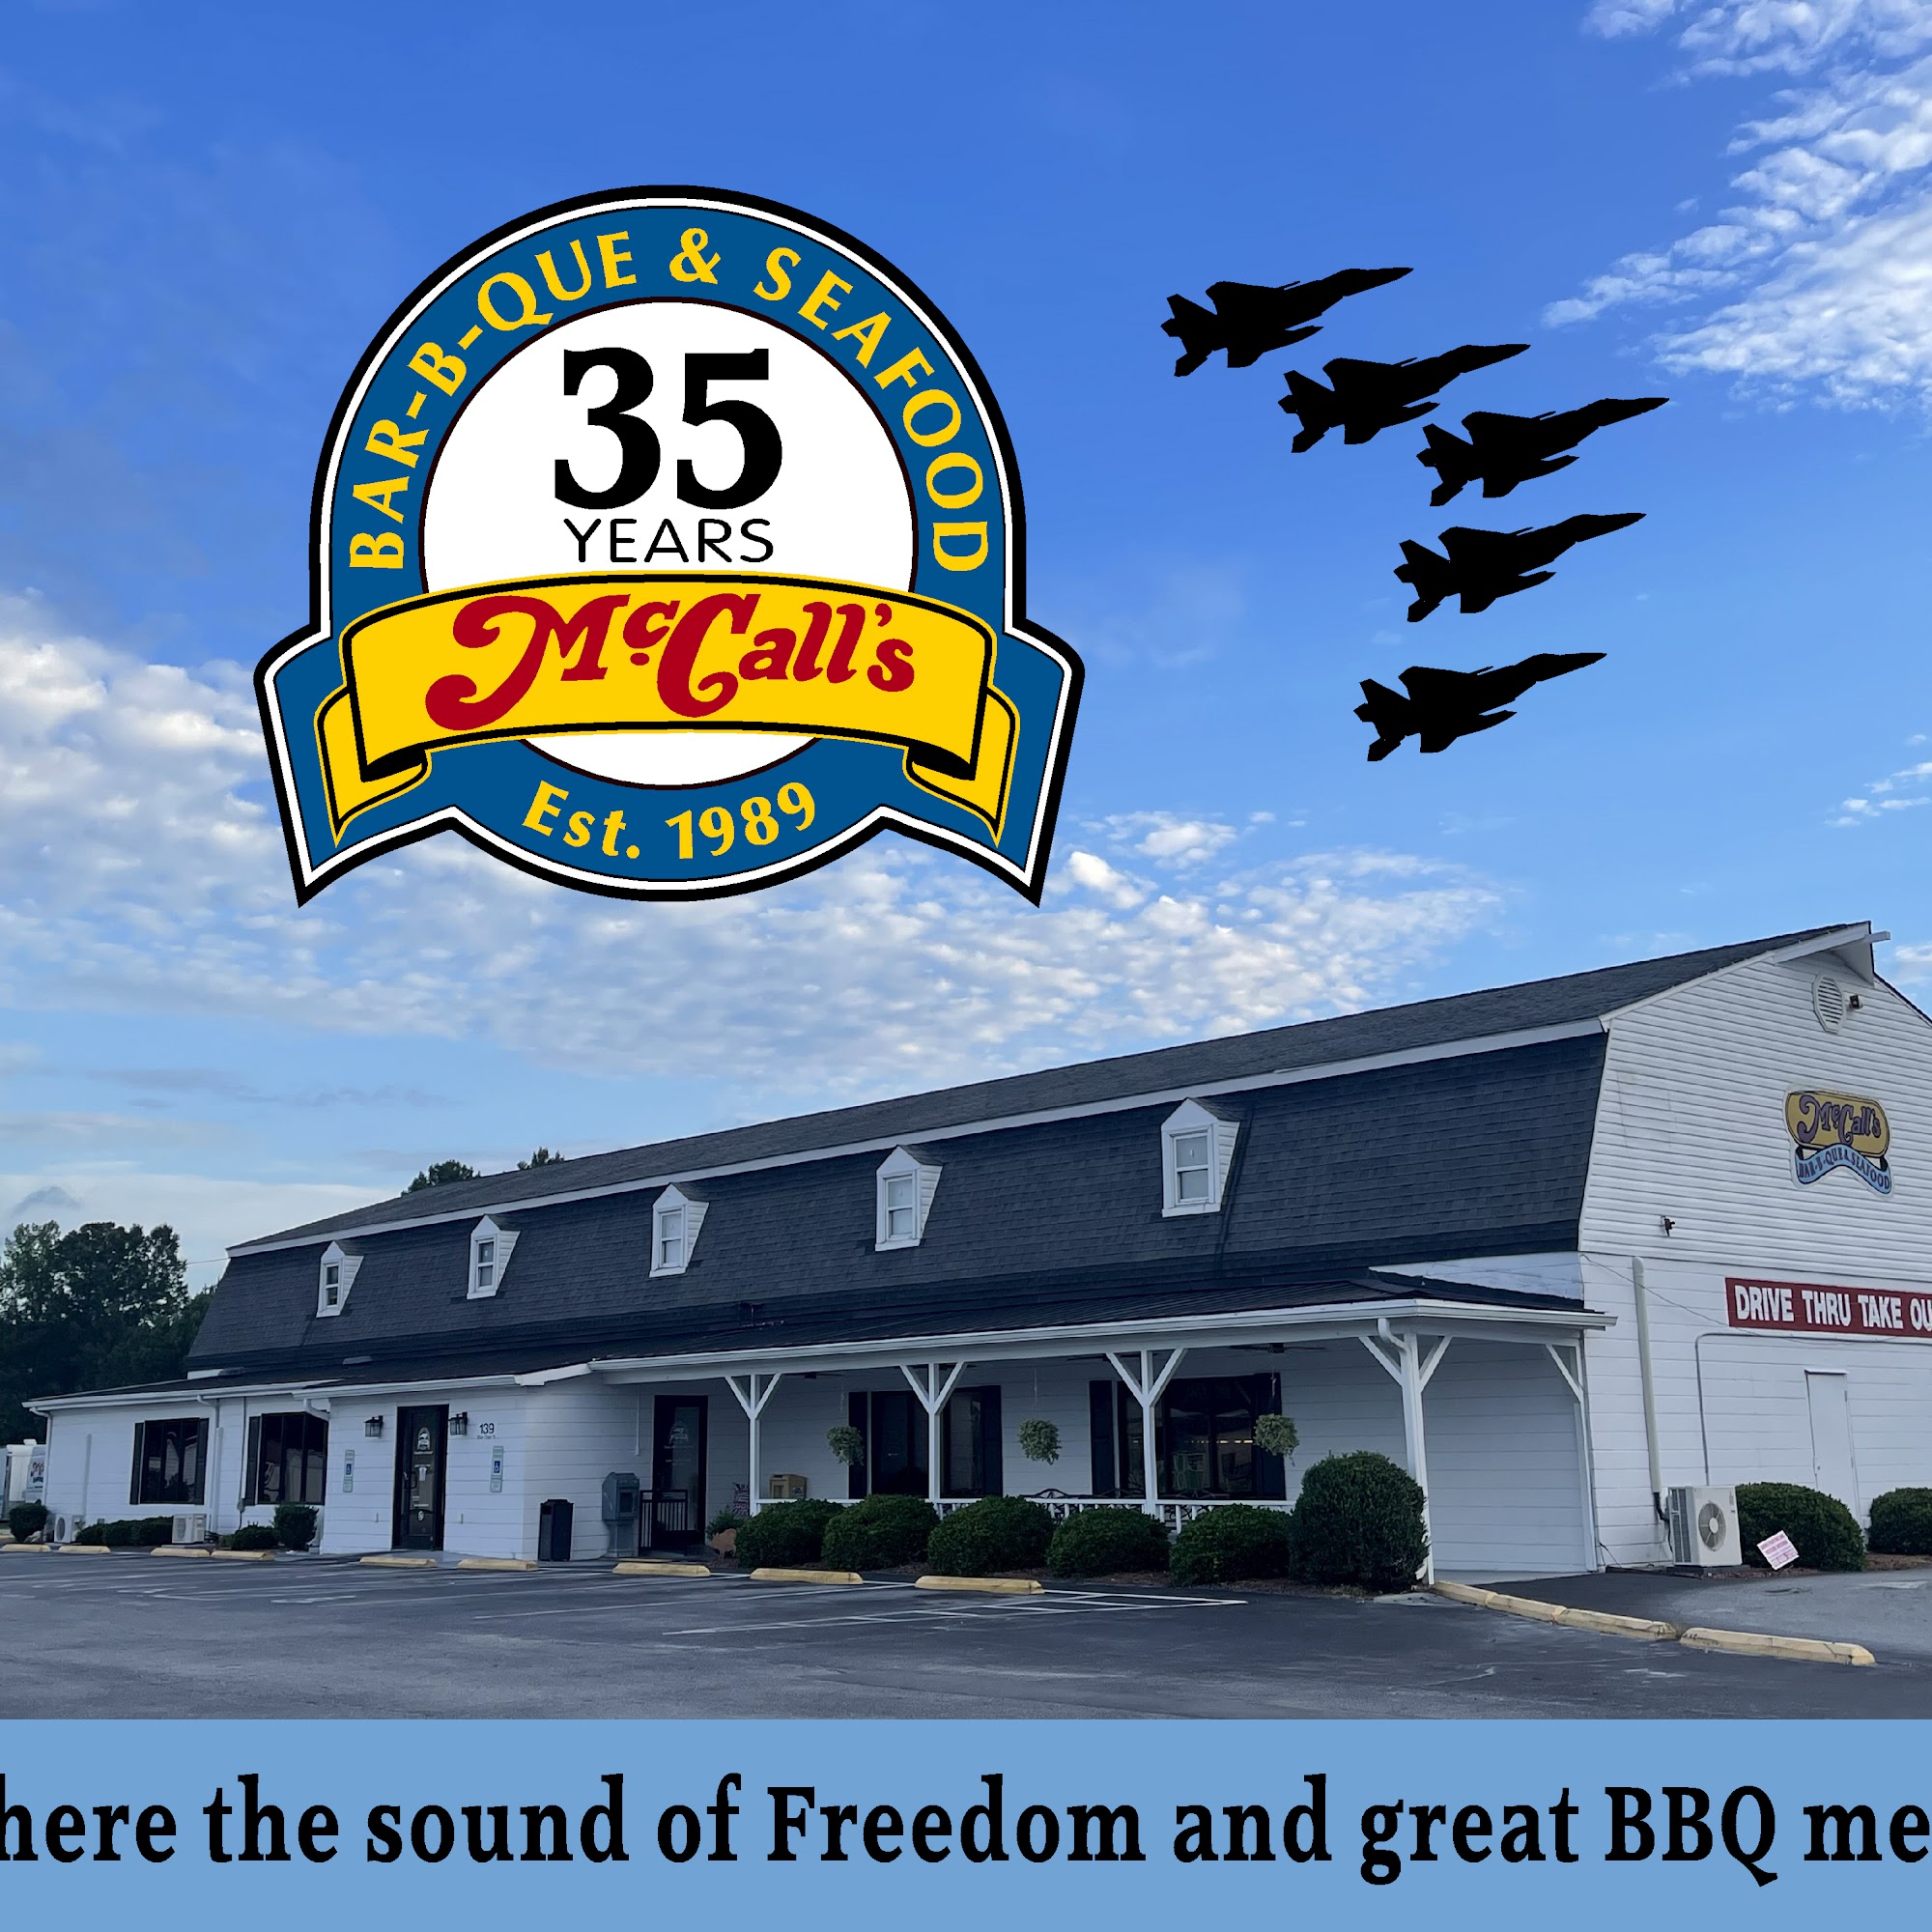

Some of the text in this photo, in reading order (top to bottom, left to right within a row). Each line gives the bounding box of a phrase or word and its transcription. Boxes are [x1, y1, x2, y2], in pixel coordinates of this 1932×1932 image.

[1797, 1094, 1882, 1148] McCall's
[1798, 1147, 1843, 1179] BAR-B-QUE
[1851, 1151, 1890, 1190] SEAFOOD
[1734, 1284, 1795, 1322] DRIVE
[1801, 1290, 1852, 1327] THRU
[1857, 1294, 1904, 1330] TAKE
[479, 1422, 495, 1435] 139
